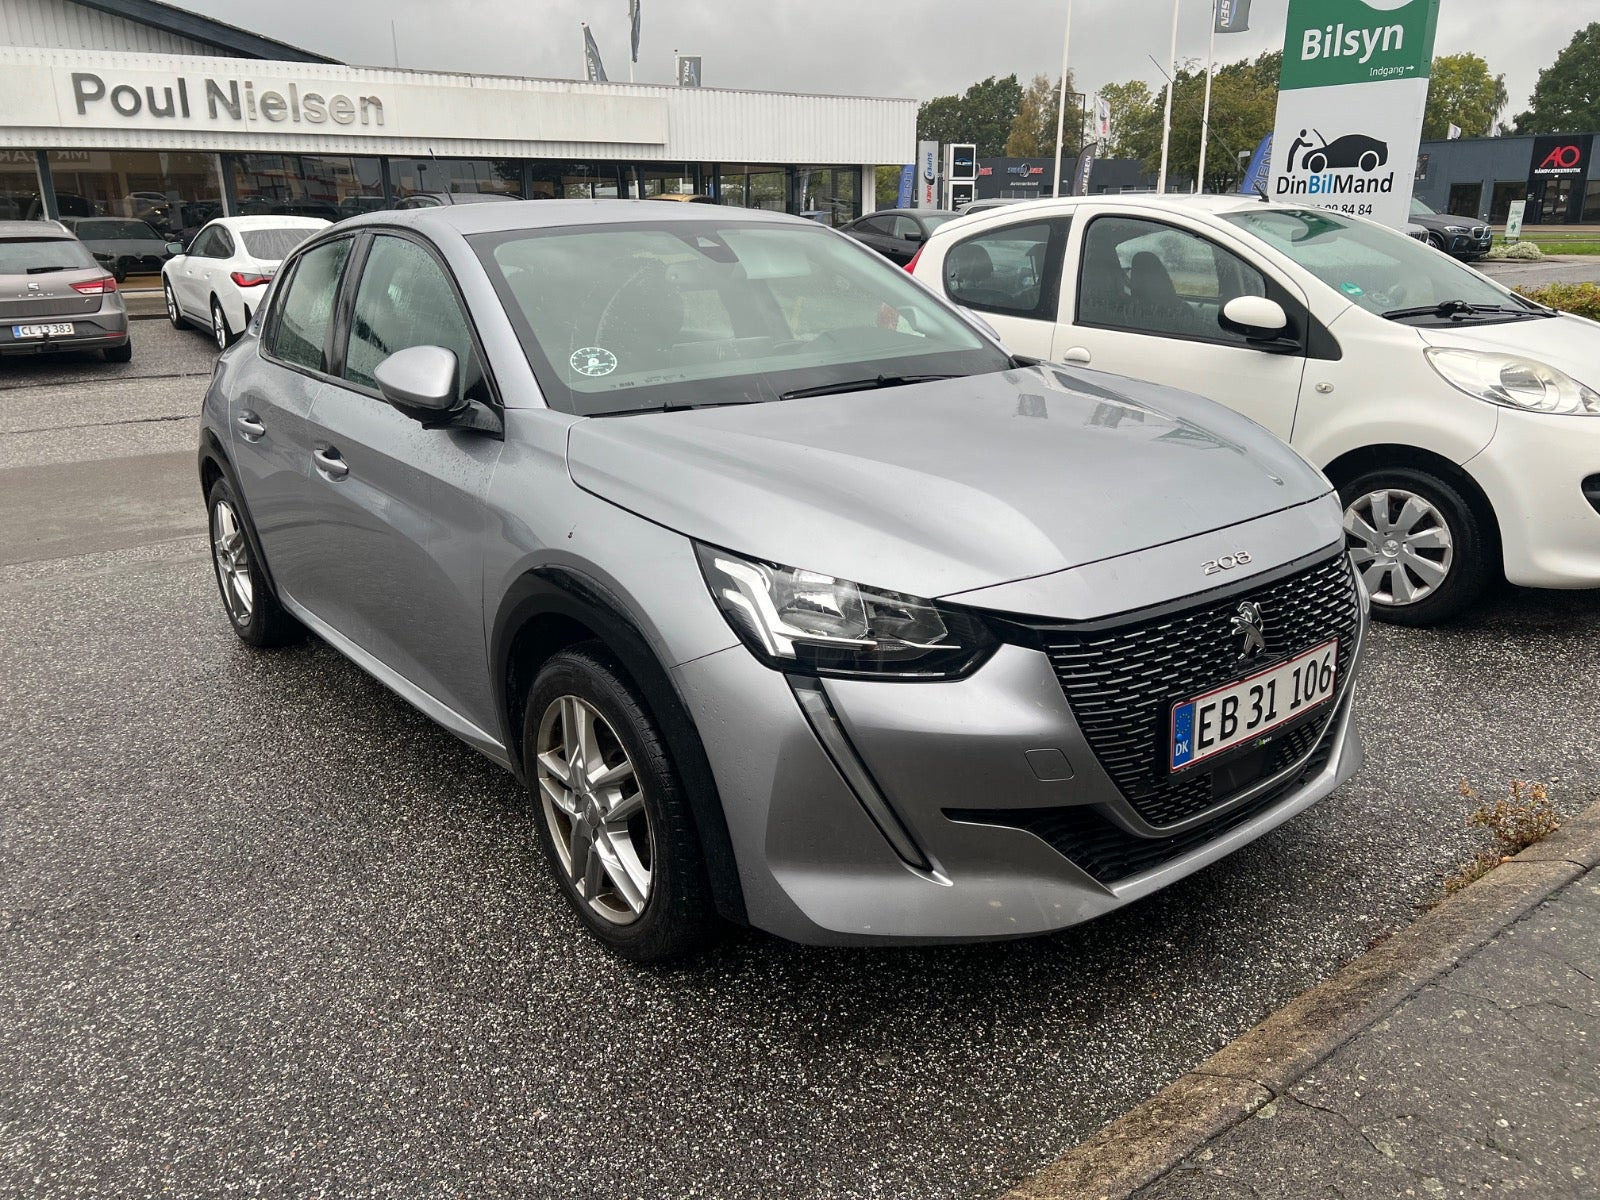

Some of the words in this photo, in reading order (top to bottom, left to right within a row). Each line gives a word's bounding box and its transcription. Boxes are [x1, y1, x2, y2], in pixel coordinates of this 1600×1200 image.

[1301, 23, 1404, 64] Bilsyn
[1369, 65, 1405, 77] Indgang
[71, 72, 190, 118] Poul
[204, 78, 384, 126] Nielsen
[1252, 136, 1273, 193] BEN
[1540, 145, 1581, 168] AO
[1276, 172, 1394, 194] DinBilMand
[1358, 204, 1373, 215] 84
[21, 326, 35, 336] CL
[39, 325, 50, 334] 13
[52, 324, 72, 334] 383
[1201, 551, 1252, 576] 208
[1197, 695, 1239, 750] EB
[1246, 678, 1277, 730] 31
[1290, 652, 1331, 710] 106
[1175, 739, 1189, 757] DK
